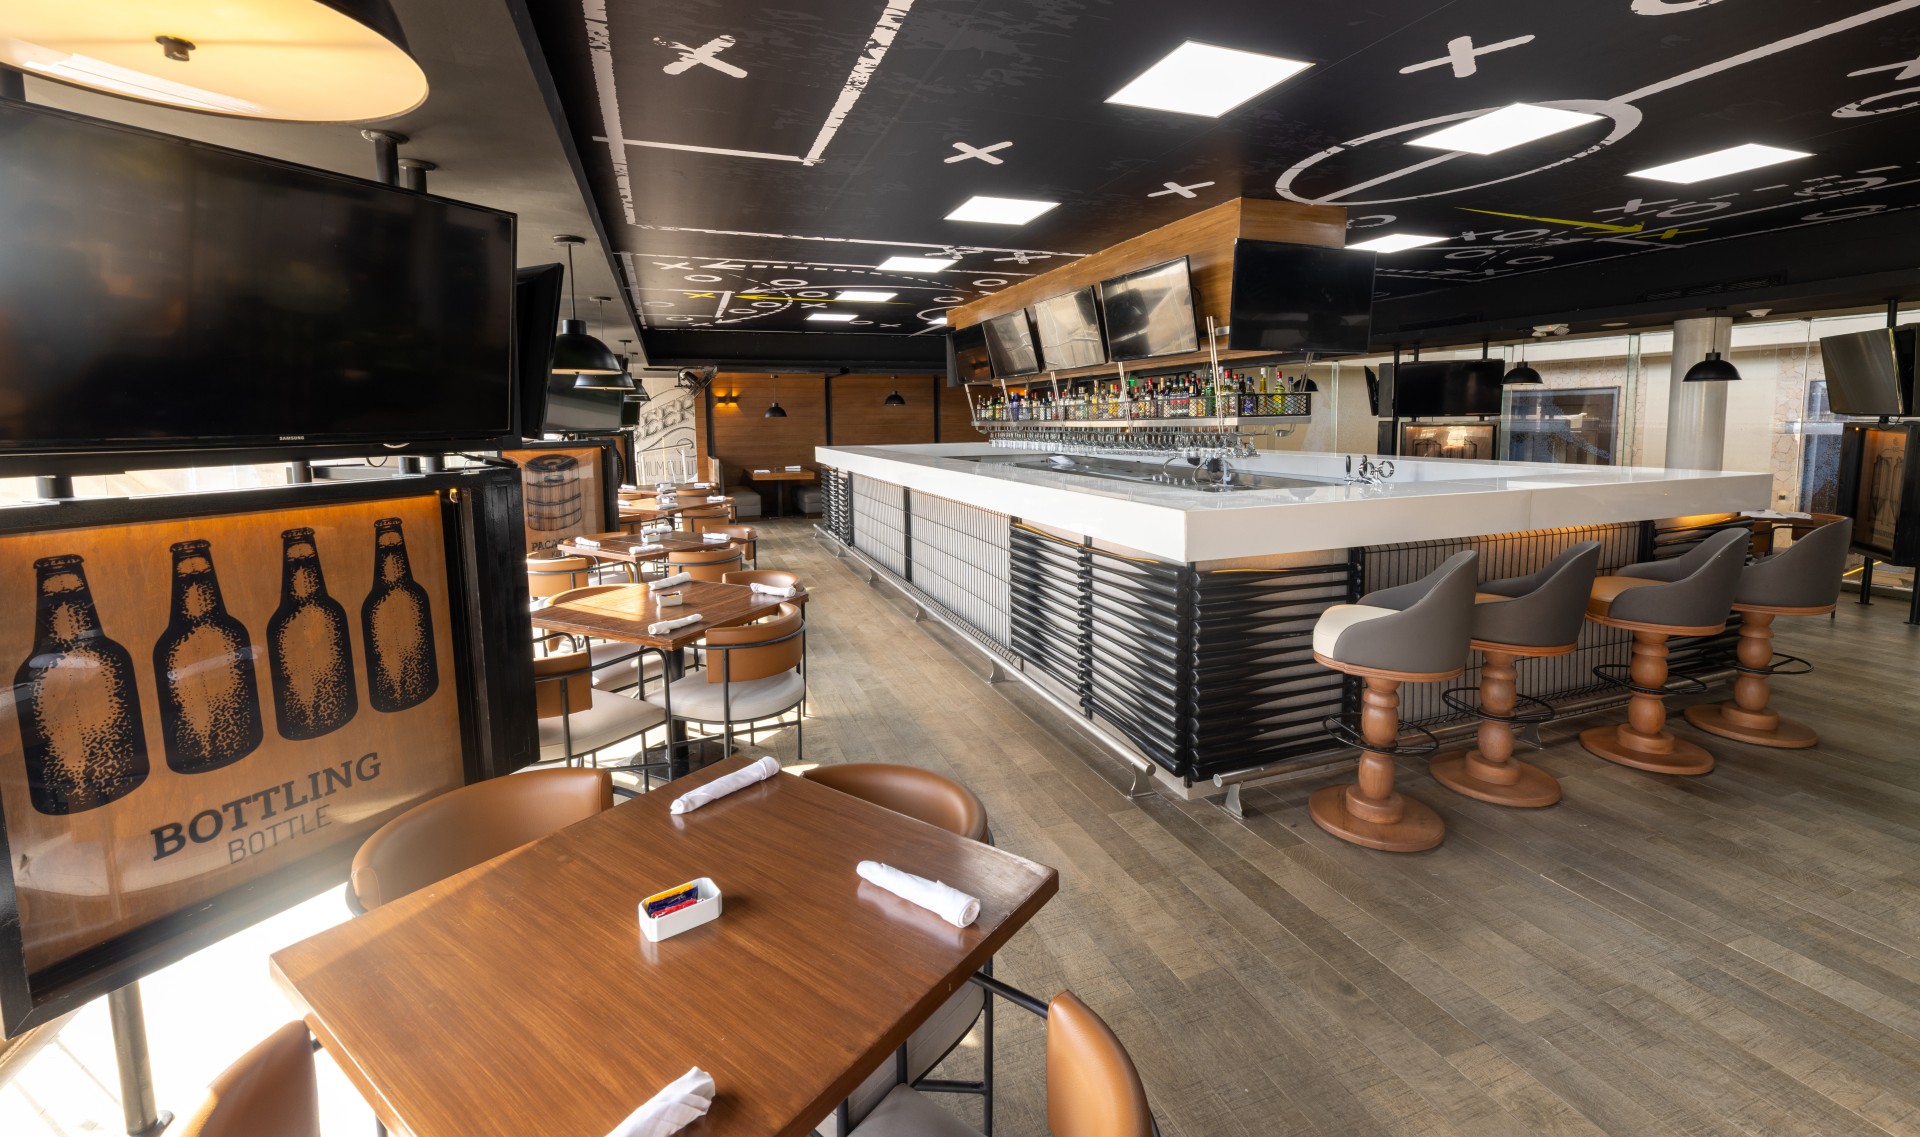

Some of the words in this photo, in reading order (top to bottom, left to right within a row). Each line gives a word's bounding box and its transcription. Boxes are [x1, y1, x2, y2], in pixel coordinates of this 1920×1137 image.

[634, 393, 695, 444] EER
[150, 752, 382, 861] BOTTLING
[227, 804, 332, 864] BOTTLE
